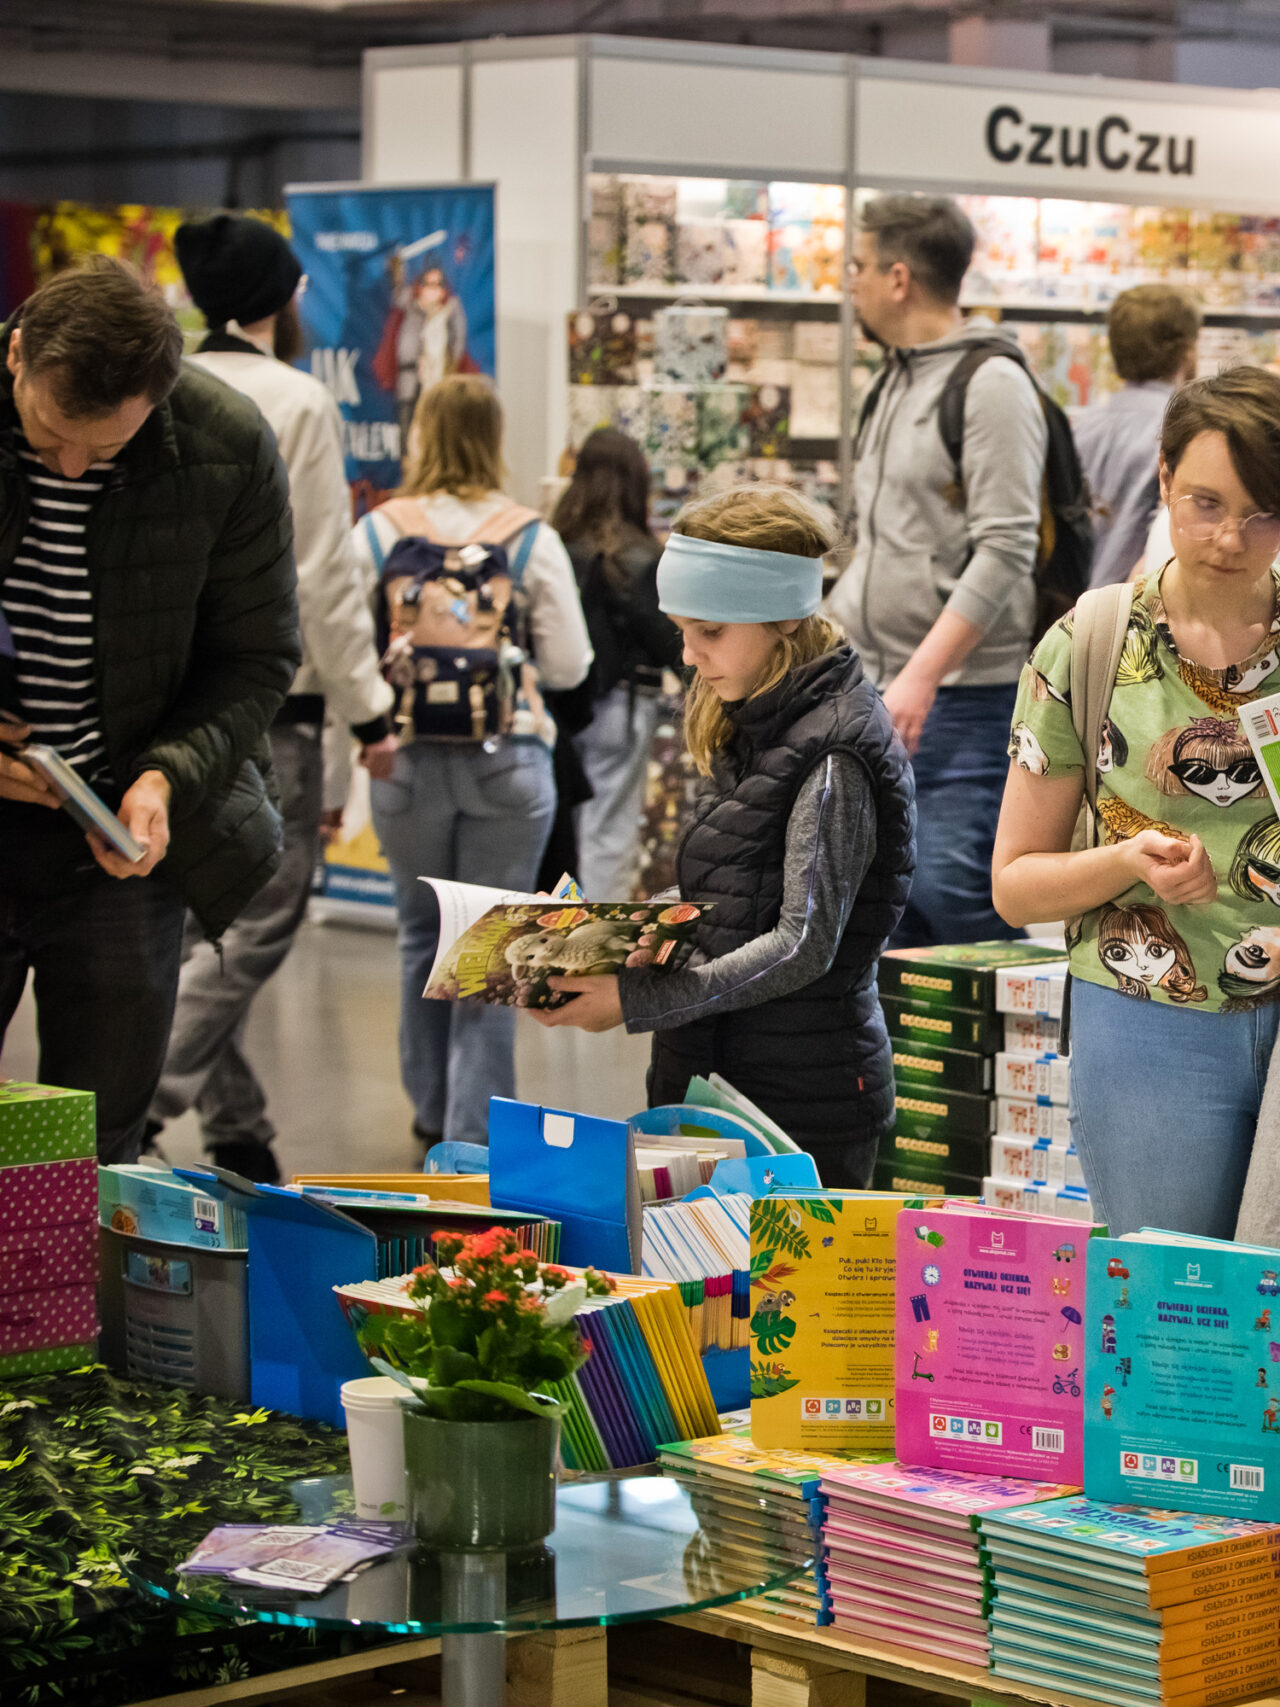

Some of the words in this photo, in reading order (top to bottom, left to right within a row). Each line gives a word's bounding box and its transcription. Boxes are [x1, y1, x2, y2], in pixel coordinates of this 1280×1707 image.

[985, 104, 1194, 176] CzuCzu
[963, 1268, 998, 1281] OTWIERAJ
[1001, 1284, 1014, 1294] UCZ
[1157, 1300, 1193, 1313] OTWIERAJ
[1197, 1317, 1211, 1327] UCZ
